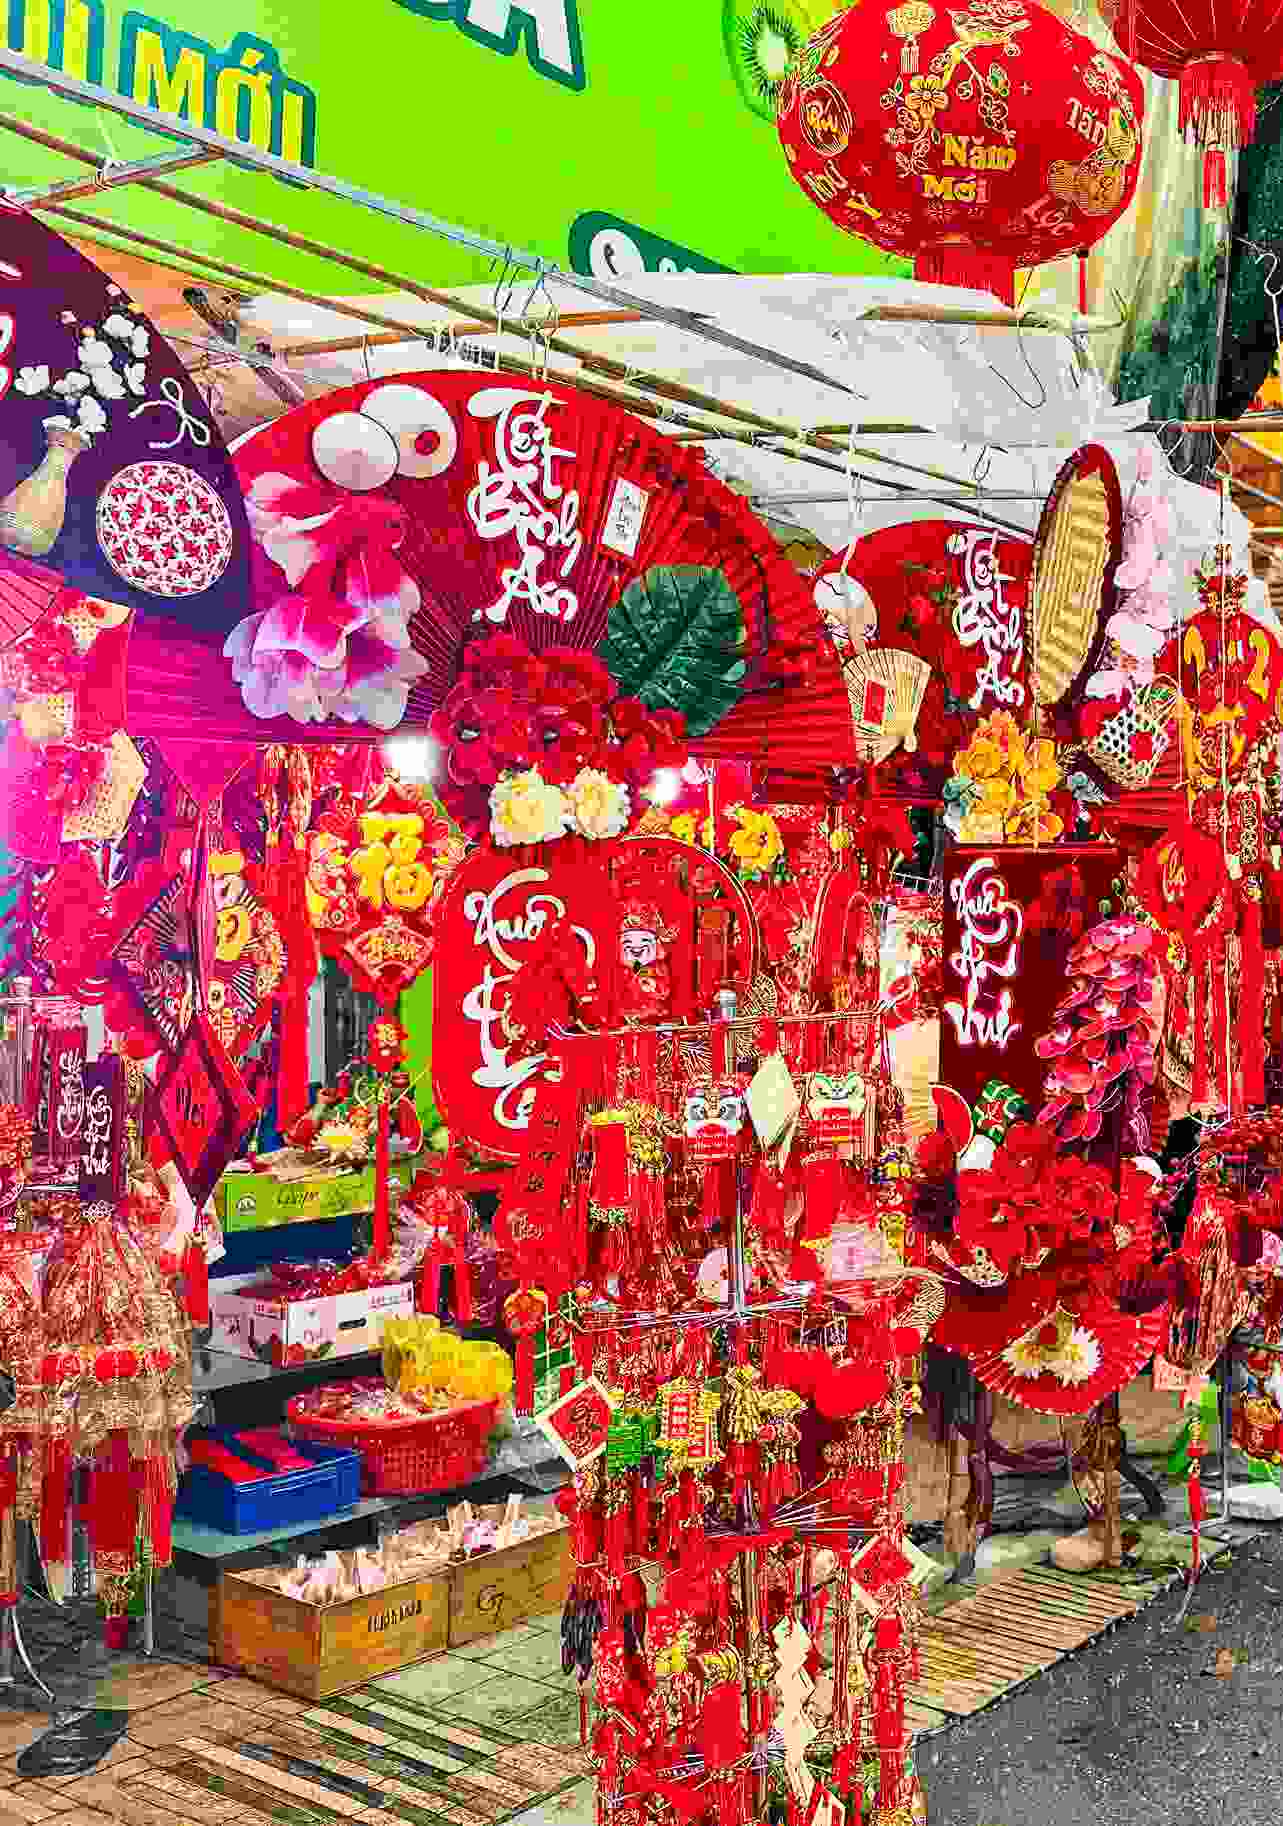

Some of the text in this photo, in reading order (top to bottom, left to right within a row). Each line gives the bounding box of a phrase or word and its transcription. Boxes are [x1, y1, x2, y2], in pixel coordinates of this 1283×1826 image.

[125, 20, 311, 175] MỚI
[942, 133, 1017, 171] Năm
[467, 386, 577, 498] Tết
